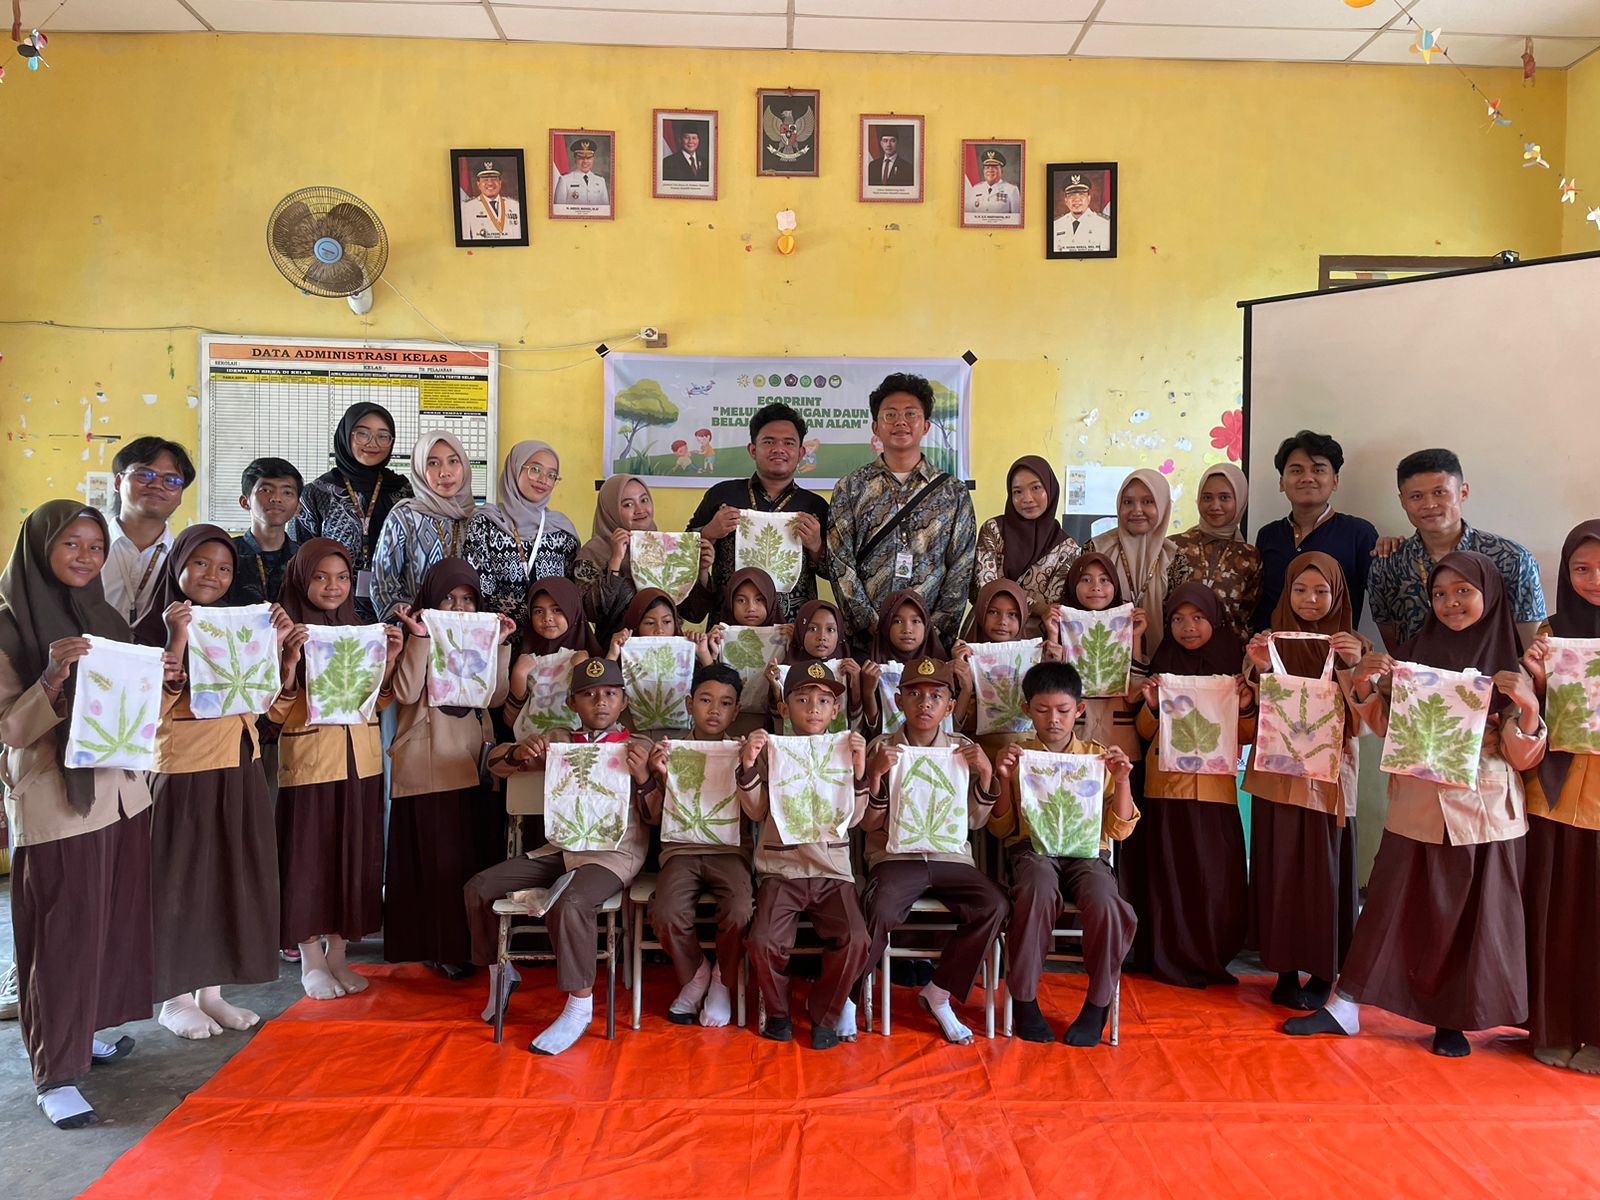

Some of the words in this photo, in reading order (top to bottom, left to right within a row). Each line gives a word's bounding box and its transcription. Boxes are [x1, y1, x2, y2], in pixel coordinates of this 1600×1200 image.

[252, 348, 290, 357] DATA
[294, 349, 397, 361] ADMINISTRASI
[402, 353, 448, 362] KELAS
[757, 396, 822, 406] ECOPRINT
[833, 408, 869, 418] DAUN
[711, 416, 750, 427] BELAJ
[825, 419, 868, 429] ALAM"
